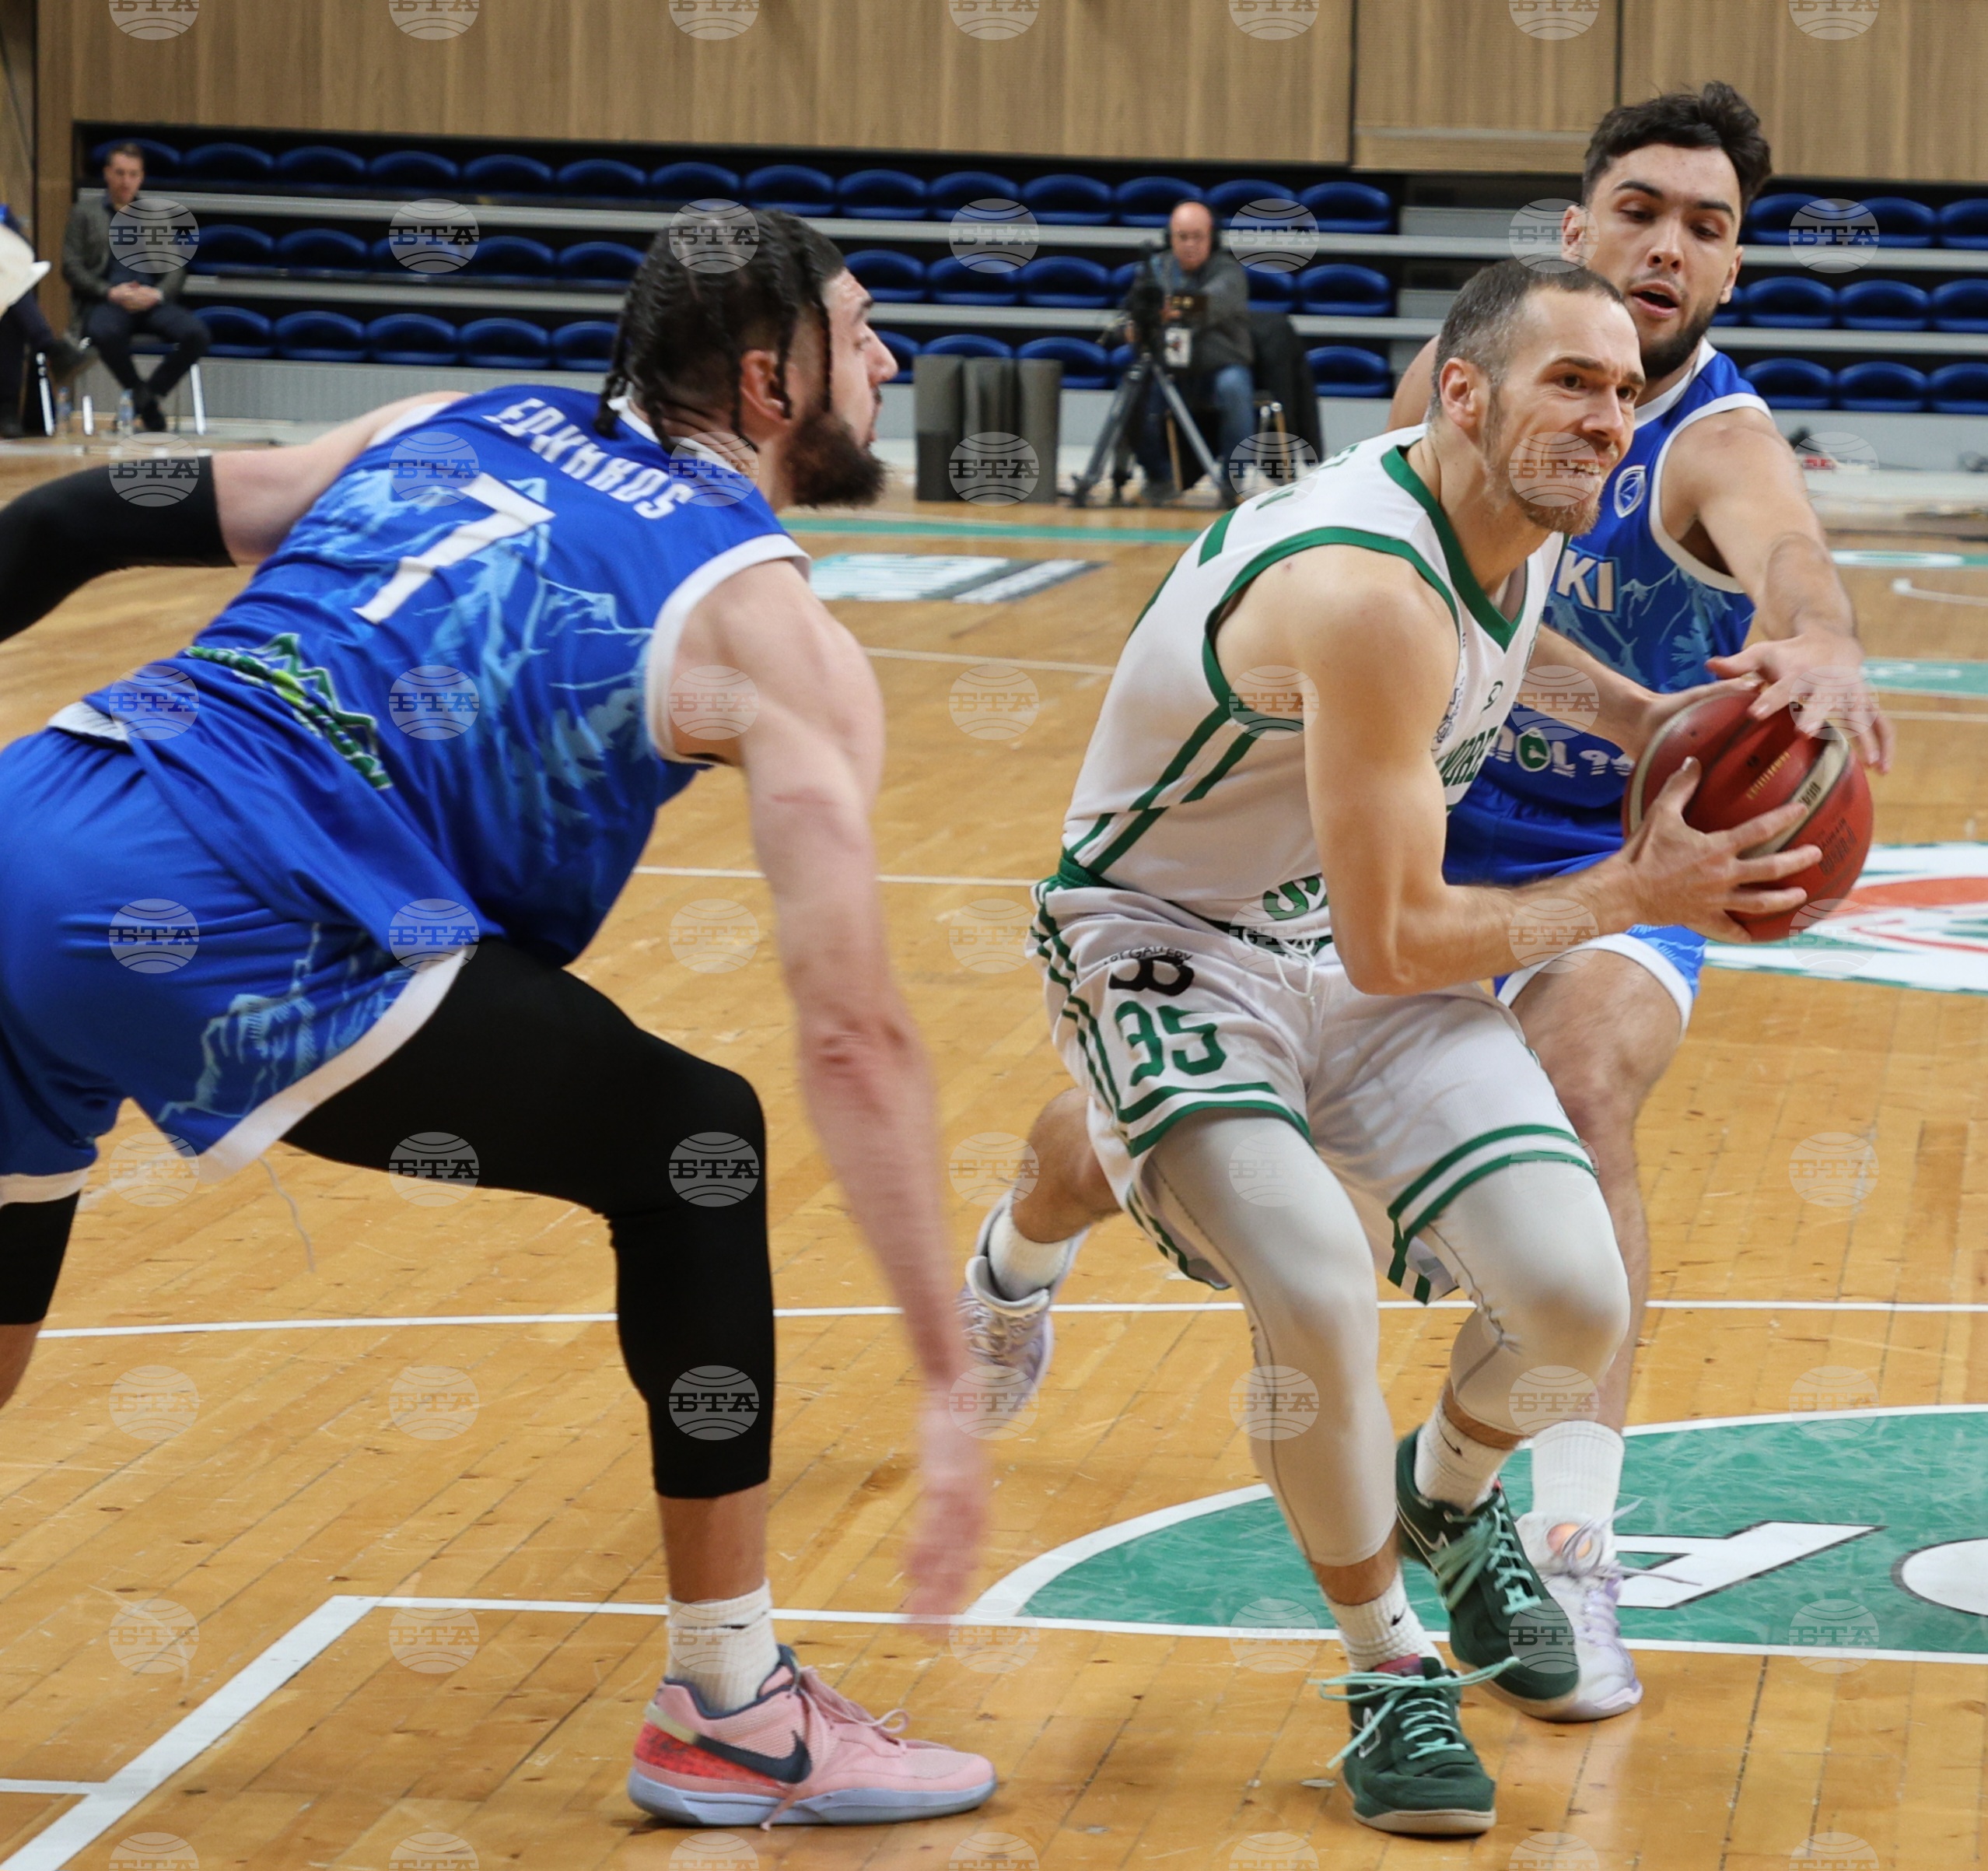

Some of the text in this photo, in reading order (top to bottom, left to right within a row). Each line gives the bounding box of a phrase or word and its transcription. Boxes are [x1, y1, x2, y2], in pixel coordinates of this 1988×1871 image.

[481, 397, 695, 520] EDWARDS
[352, 471, 557, 625] 7
[1556, 548, 1615, 612] KI
[1115, 1000, 1227, 1087] 35
